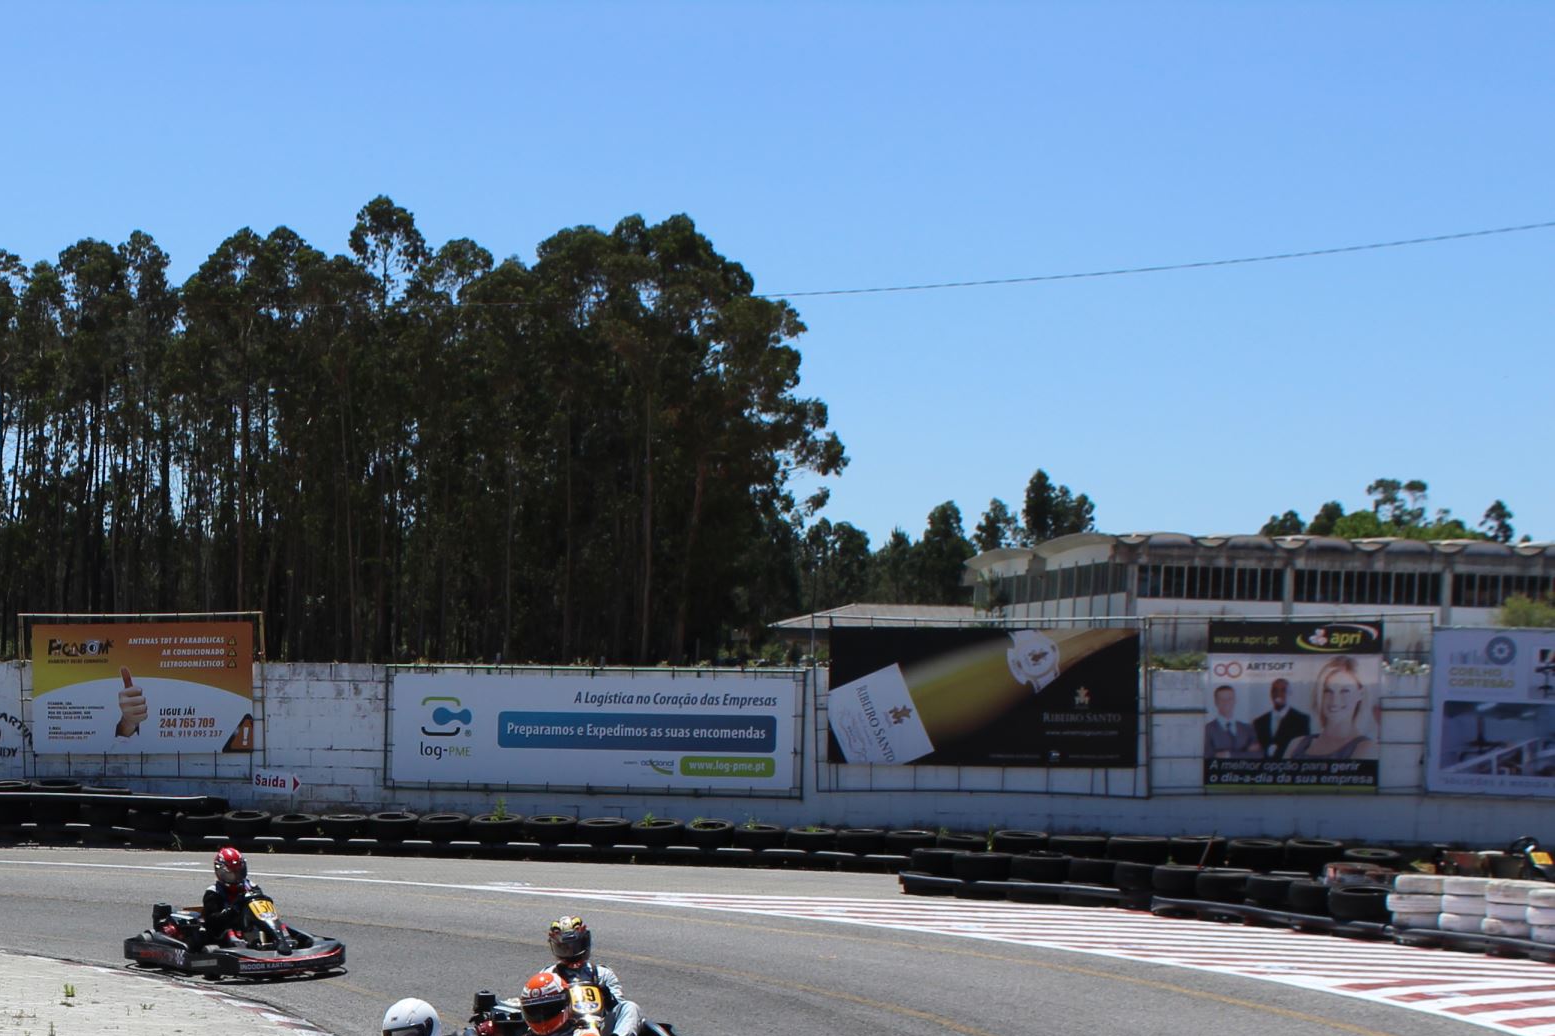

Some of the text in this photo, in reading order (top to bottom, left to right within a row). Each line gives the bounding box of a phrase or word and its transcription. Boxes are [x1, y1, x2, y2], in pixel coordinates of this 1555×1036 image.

[127, 637, 158, 645] ANTENAS
[1213, 634, 1279, 645] www.apri.pt
[1329, 630, 1363, 648] apri
[172, 648, 225, 656] CONDICIONADO
[159, 659, 225, 668] ELETRODOMÉSTICOS
[1246, 661, 1294, 671] ARTSOFT
[574, 690, 777, 710] A Logística no Coração das Empresas
[855, 684, 880, 729] RIBEIRO
[159, 706, 195, 716] LIGUE JÁ!
[1042, 711, 1122, 723] RIBEIRO SANTO
[159, 717, 215, 728] 244 765 709
[507, 722, 766, 741] Preparamos e Expedimos as suas encomendas
[419, 741, 472, 760] log-PME
[873, 728, 896, 763] SANTO
[688, 759, 766, 774] www.log-pme.pt
[1209, 760, 1360, 773] A melhor opção para gerir
[255, 774, 286, 788] Saída
[1209, 773, 1374, 786] o dia-a-dia da sua empresa
